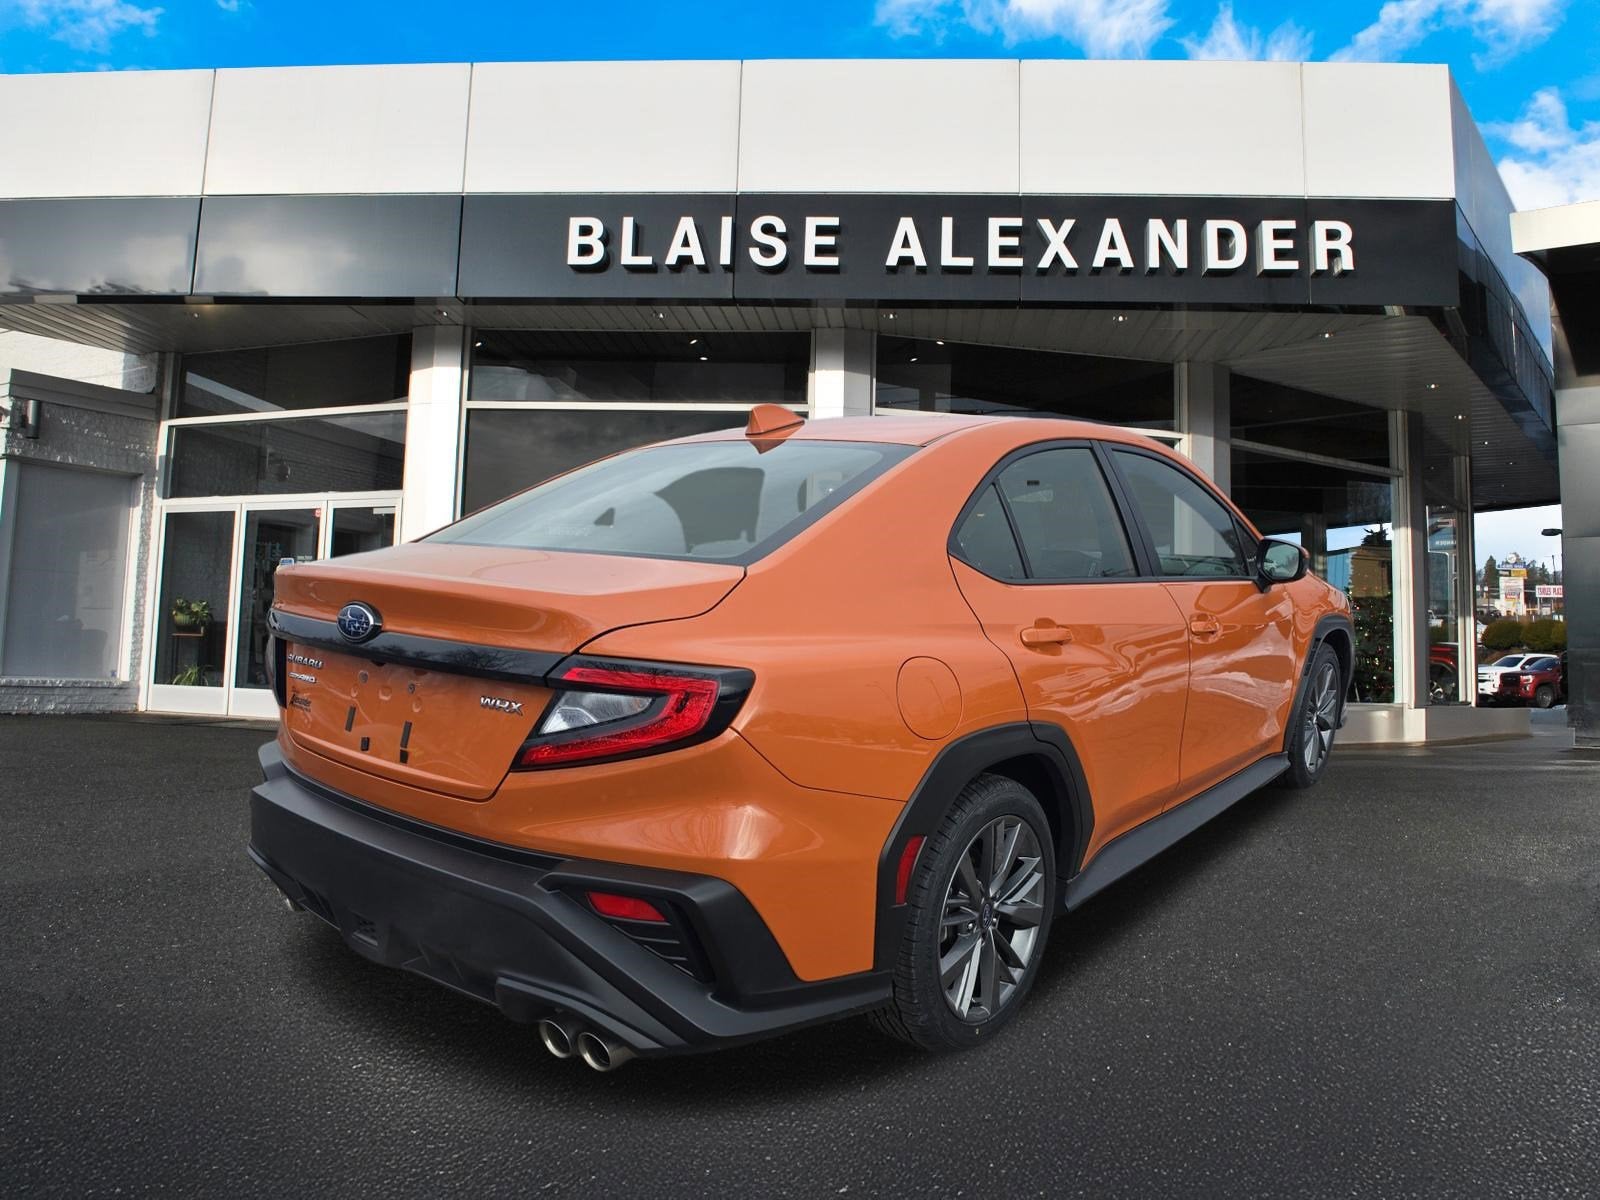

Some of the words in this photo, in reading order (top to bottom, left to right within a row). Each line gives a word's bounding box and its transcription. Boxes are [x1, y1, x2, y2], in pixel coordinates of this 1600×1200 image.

[567, 215, 841, 270] BLAISE
[885, 216, 1355, 273] ALEXANDER
[288, 653, 323, 669] SUBARU
[480, 696, 523, 716] WRX
